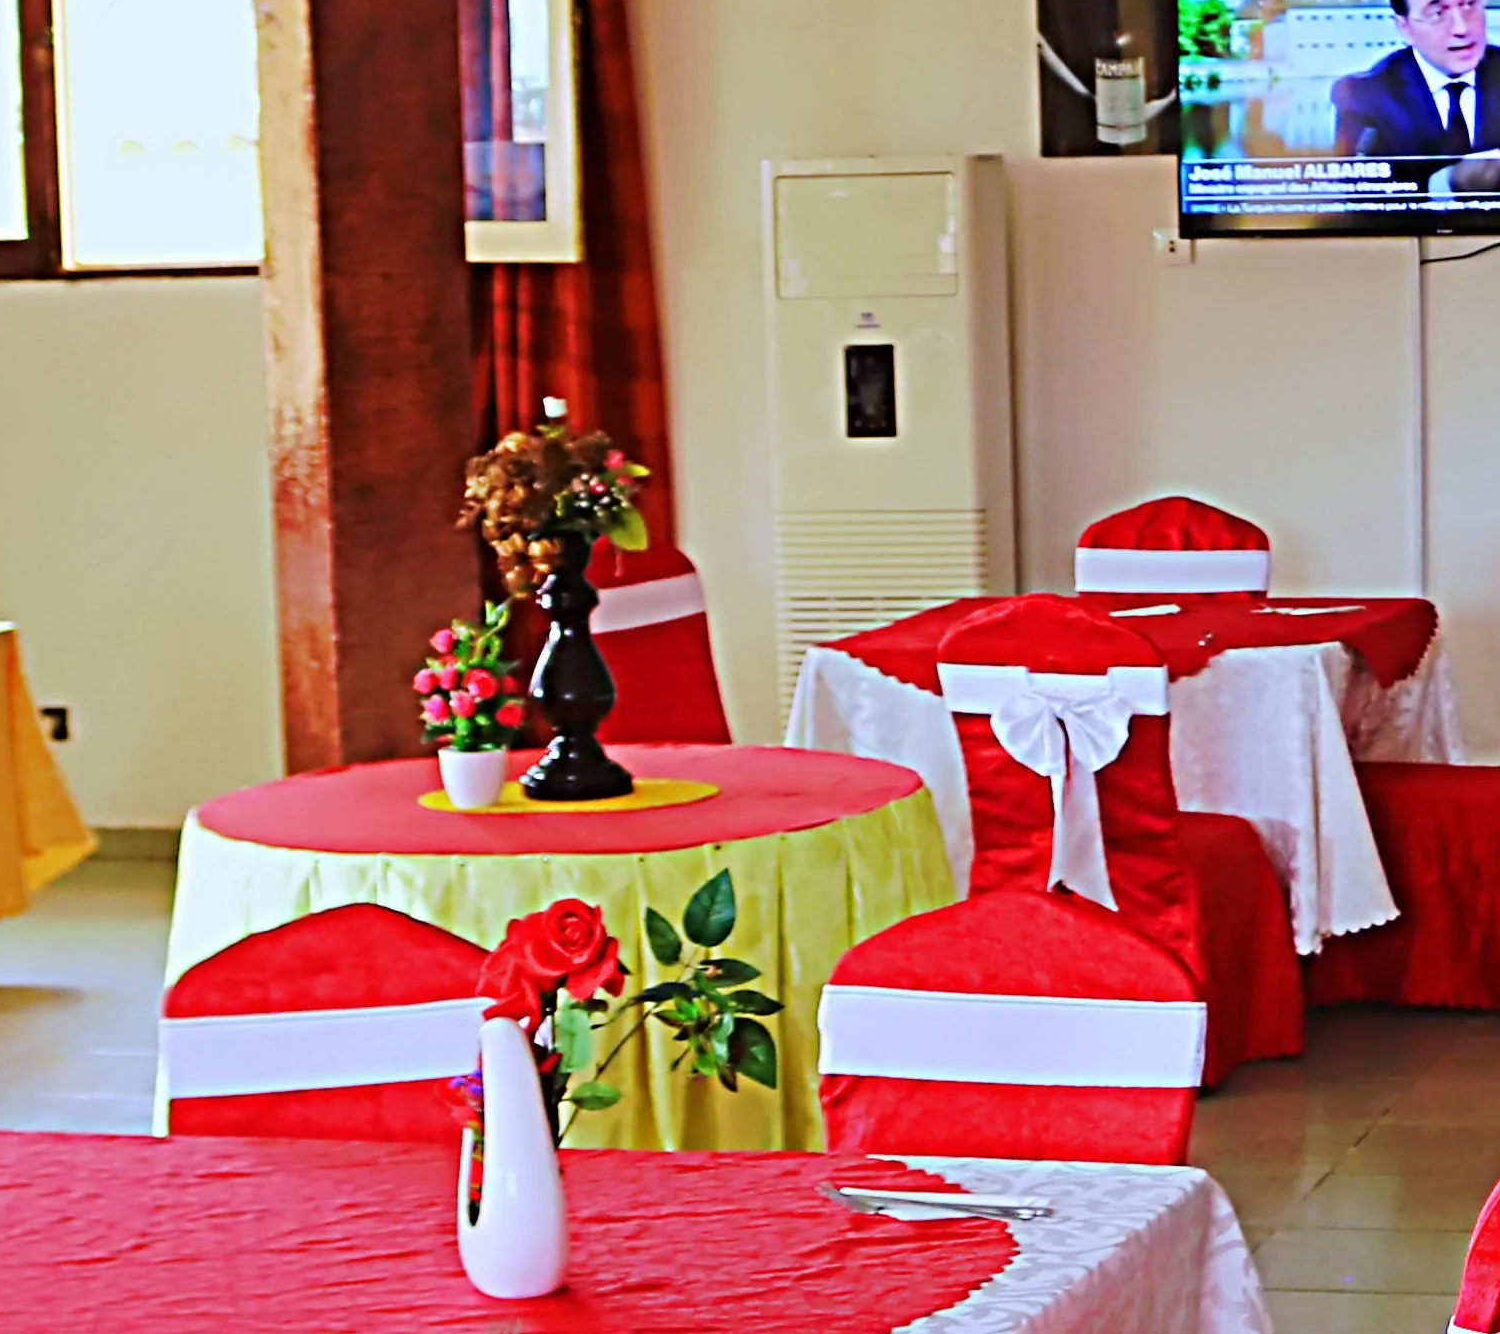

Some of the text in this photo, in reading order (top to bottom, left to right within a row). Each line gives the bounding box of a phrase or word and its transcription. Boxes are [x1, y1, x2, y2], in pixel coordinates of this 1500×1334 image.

[1188, 162, 1391, 181] José Manuel ALBARES
